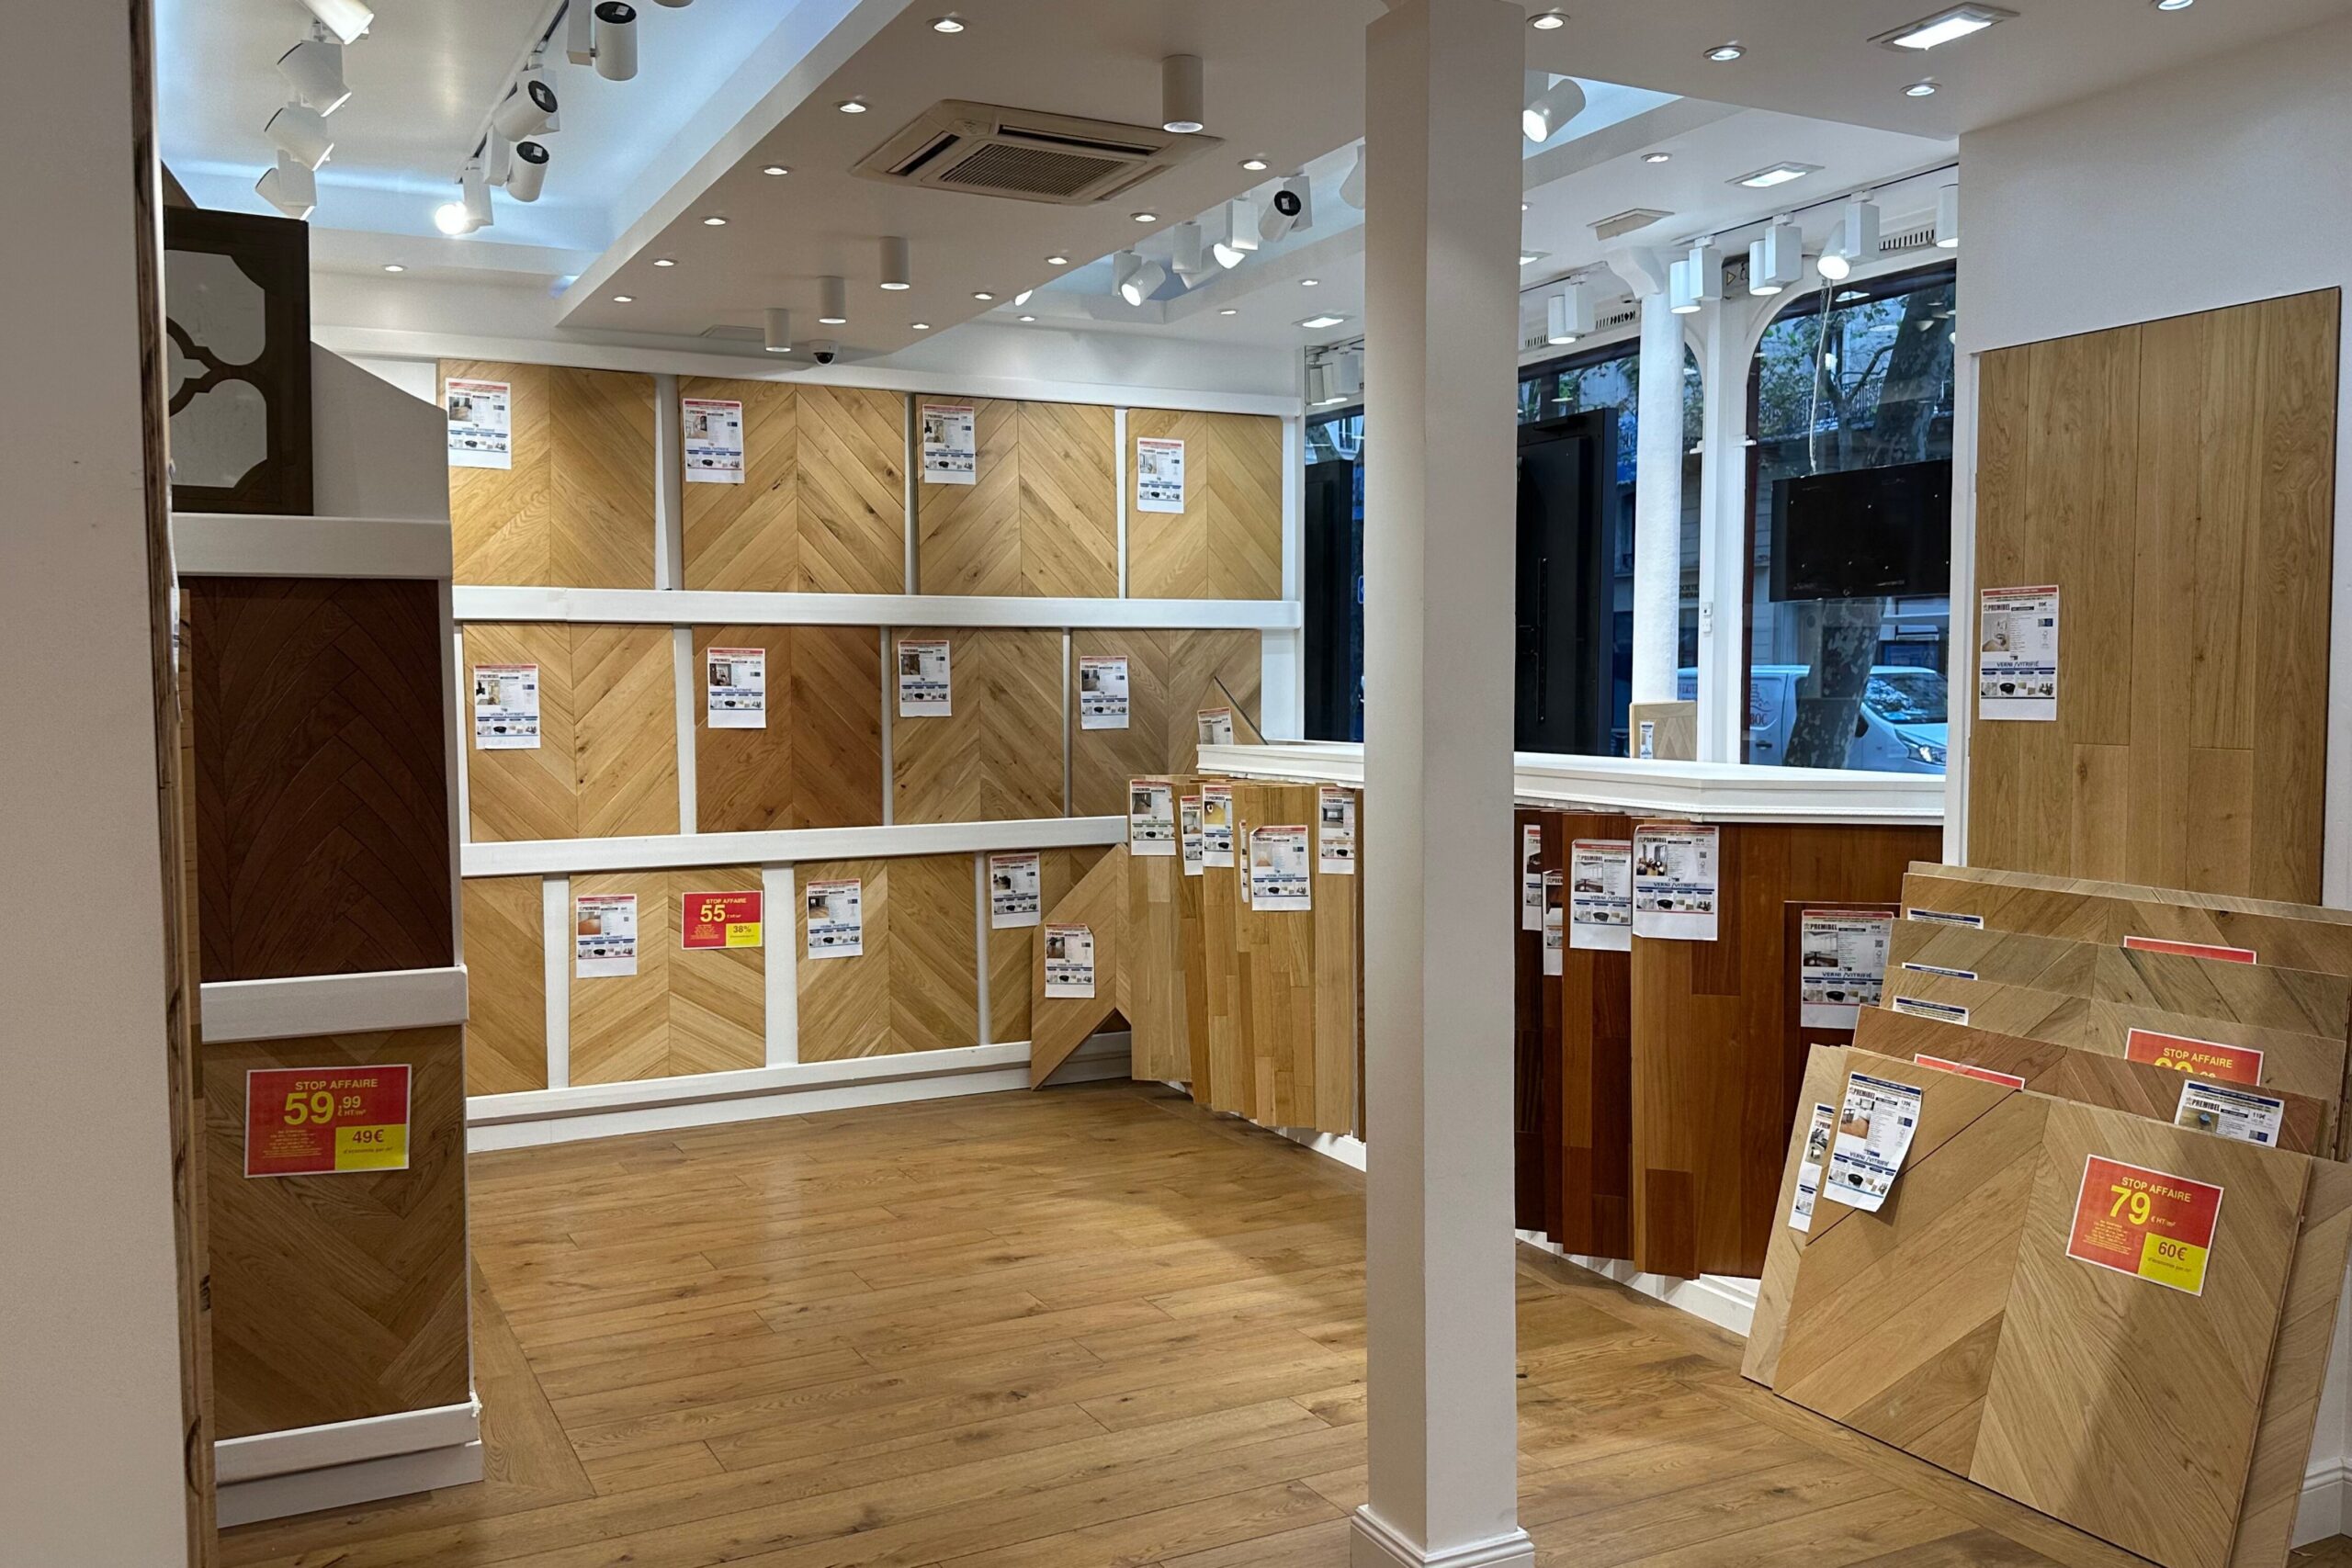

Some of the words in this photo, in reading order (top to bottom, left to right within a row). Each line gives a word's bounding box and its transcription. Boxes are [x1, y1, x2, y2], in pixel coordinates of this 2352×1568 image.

[700, 904, 726, 922] 55
[733, 925, 752, 933] 38%
[2164, 1047, 2189, 1060] STOP
[2191, 1053, 2233, 1068] AFFAIRE
[295, 1081, 327, 1091] STOP
[329, 1078, 379, 1089] AFFAIRE
[284, 1090, 334, 1125] 59
[353, 1129, 384, 1144] 49€
[2121, 1177, 2148, 1190] STOP
[2149, 1184, 2191, 1202] AFFAIRE
[2109, 1184, 2151, 1225] 79
[2158, 1242, 2188, 1261] 60€
